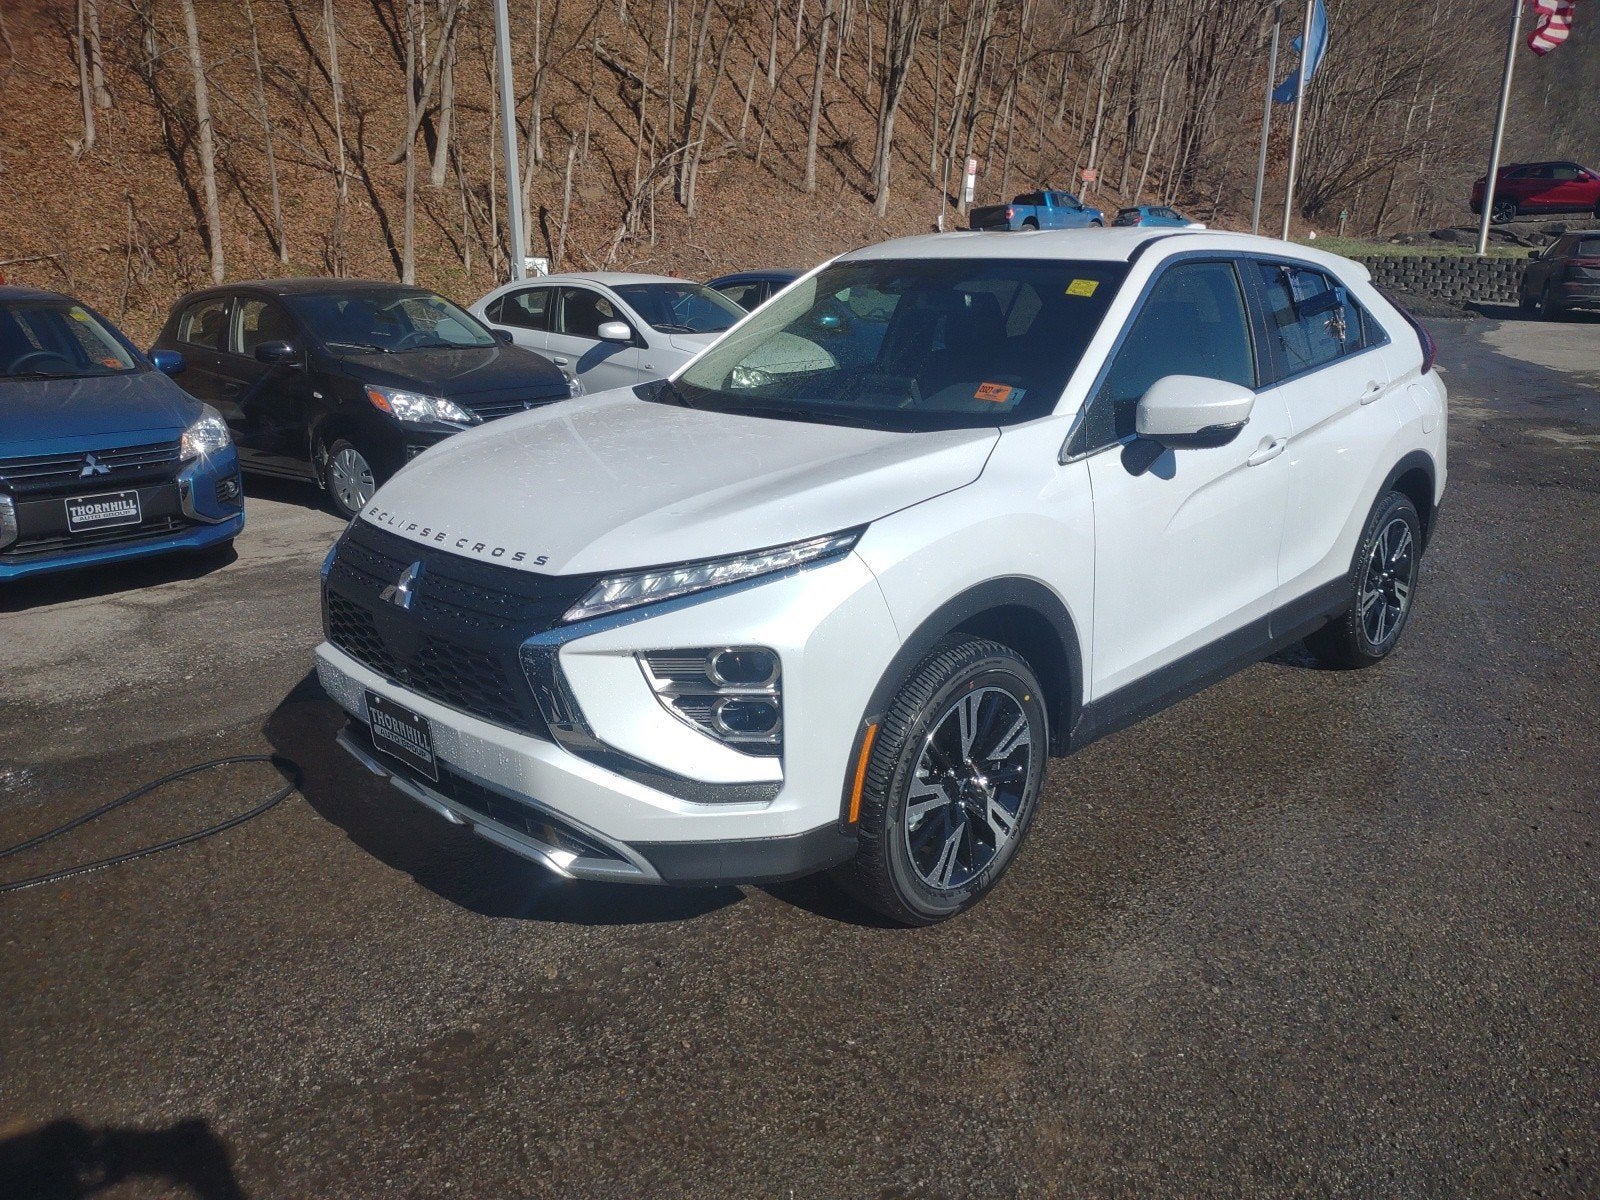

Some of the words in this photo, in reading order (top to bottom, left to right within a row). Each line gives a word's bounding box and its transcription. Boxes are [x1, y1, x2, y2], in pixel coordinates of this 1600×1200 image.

[69, 499, 136, 516] THORNHILL
[79, 513, 101, 521] AUTO
[369, 507, 446, 541] ECLIPSE
[455, 538, 549, 566] CROSS
[369, 706, 431, 751] THORNHILL
